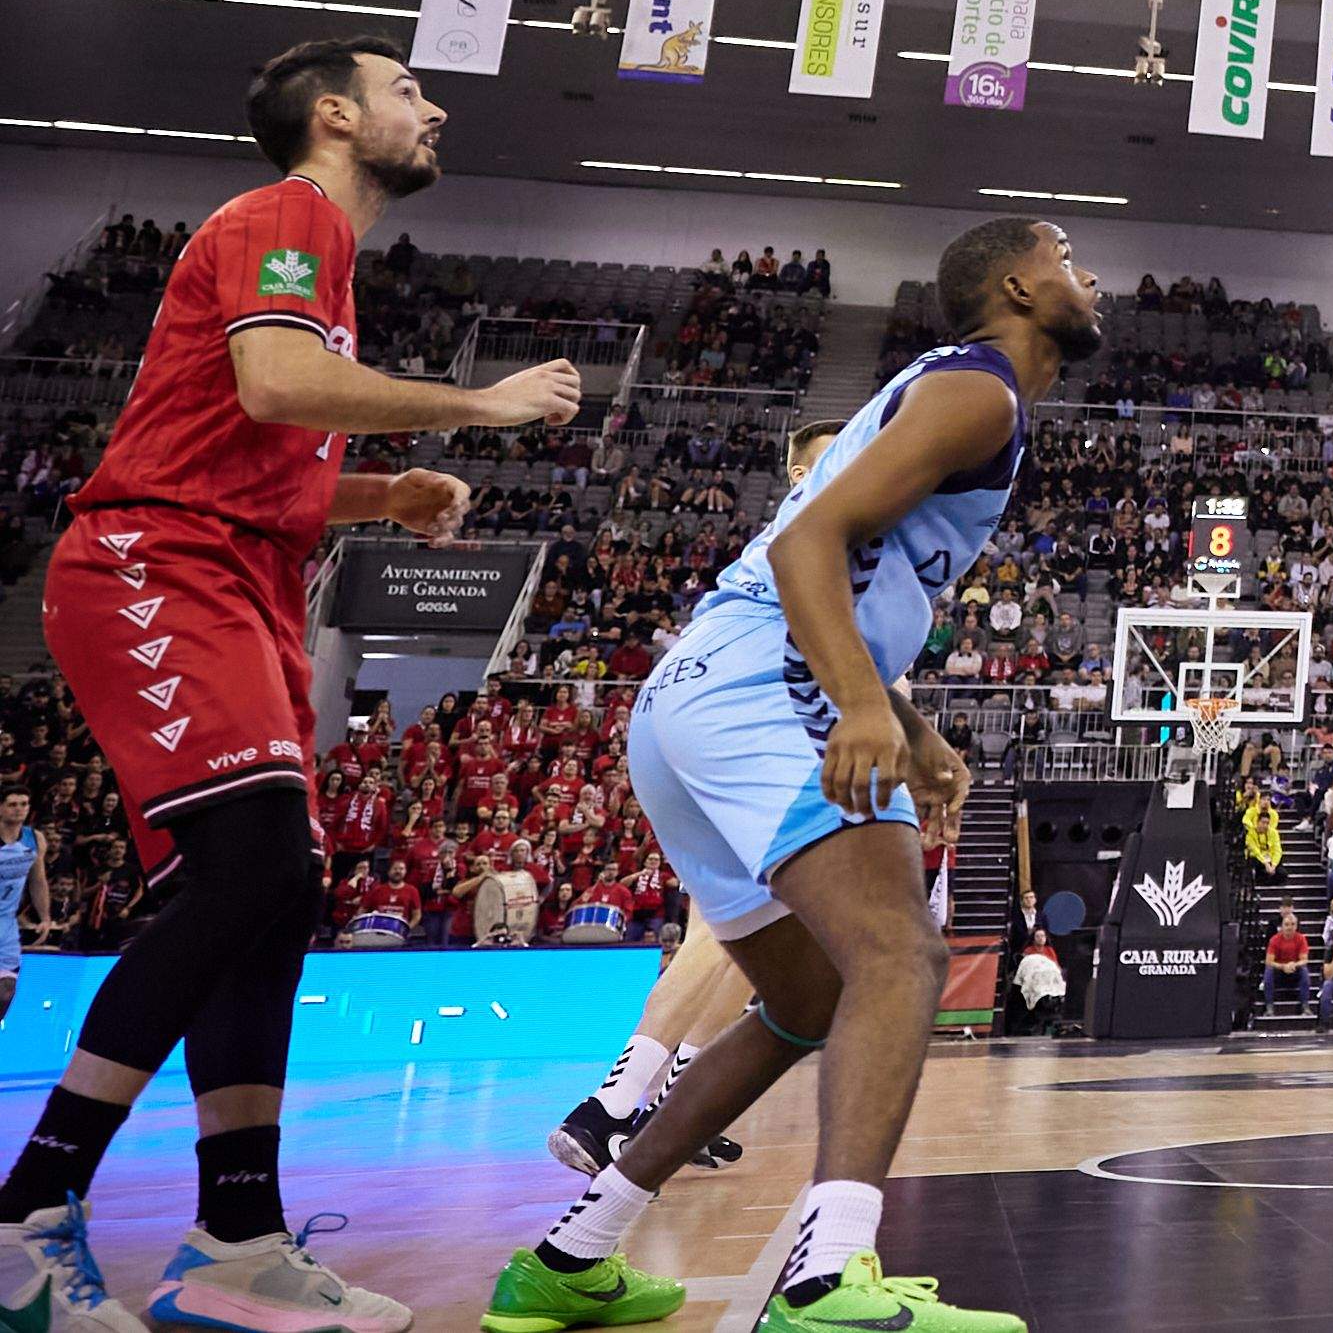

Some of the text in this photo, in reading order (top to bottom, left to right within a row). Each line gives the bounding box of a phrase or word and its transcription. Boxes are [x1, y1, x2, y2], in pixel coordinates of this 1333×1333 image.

[984, 31, 1004, 57] de
[968, 75, 1004, 97] 16h
[1210, 526, 1232, 557] 8
[381, 564, 501, 581] AYUNTAMIENTO
[387, 581, 487, 598] DE GRANADA
[207, 747, 258, 770] vive
[1119, 949, 1218, 965] CAJA RURAL
[1138, 964, 1197, 976] GRANADA
